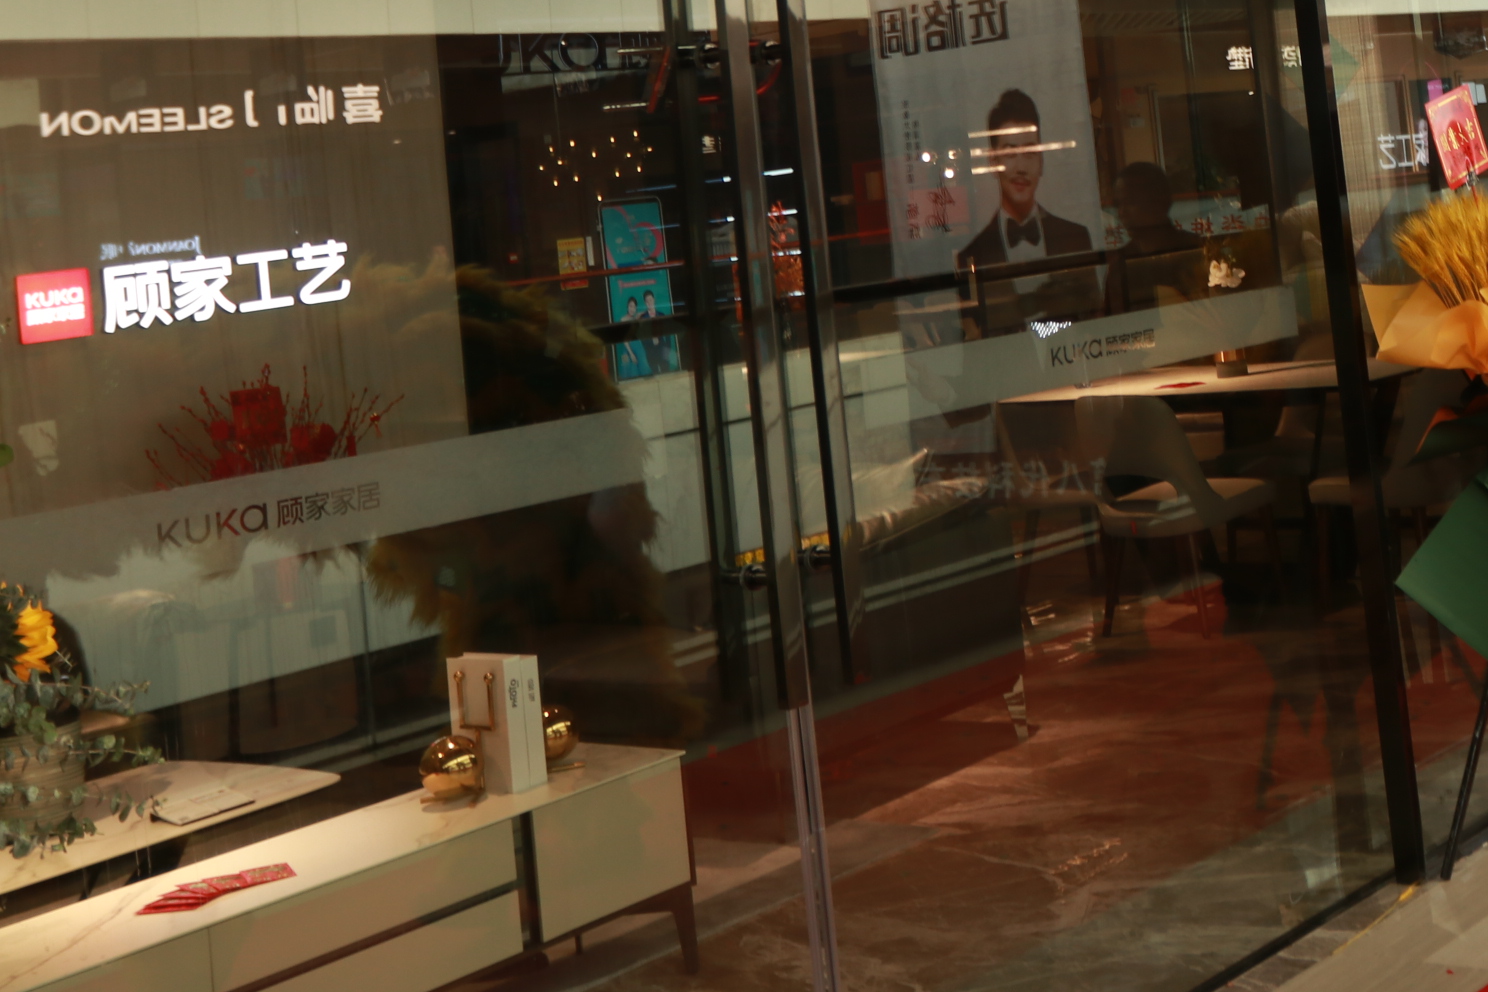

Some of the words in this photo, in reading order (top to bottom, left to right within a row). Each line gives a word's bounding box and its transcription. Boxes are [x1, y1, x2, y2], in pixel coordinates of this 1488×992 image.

[102, 239, 352, 335] 顾家工艺
[276, 481, 381, 529] 顾家家居
